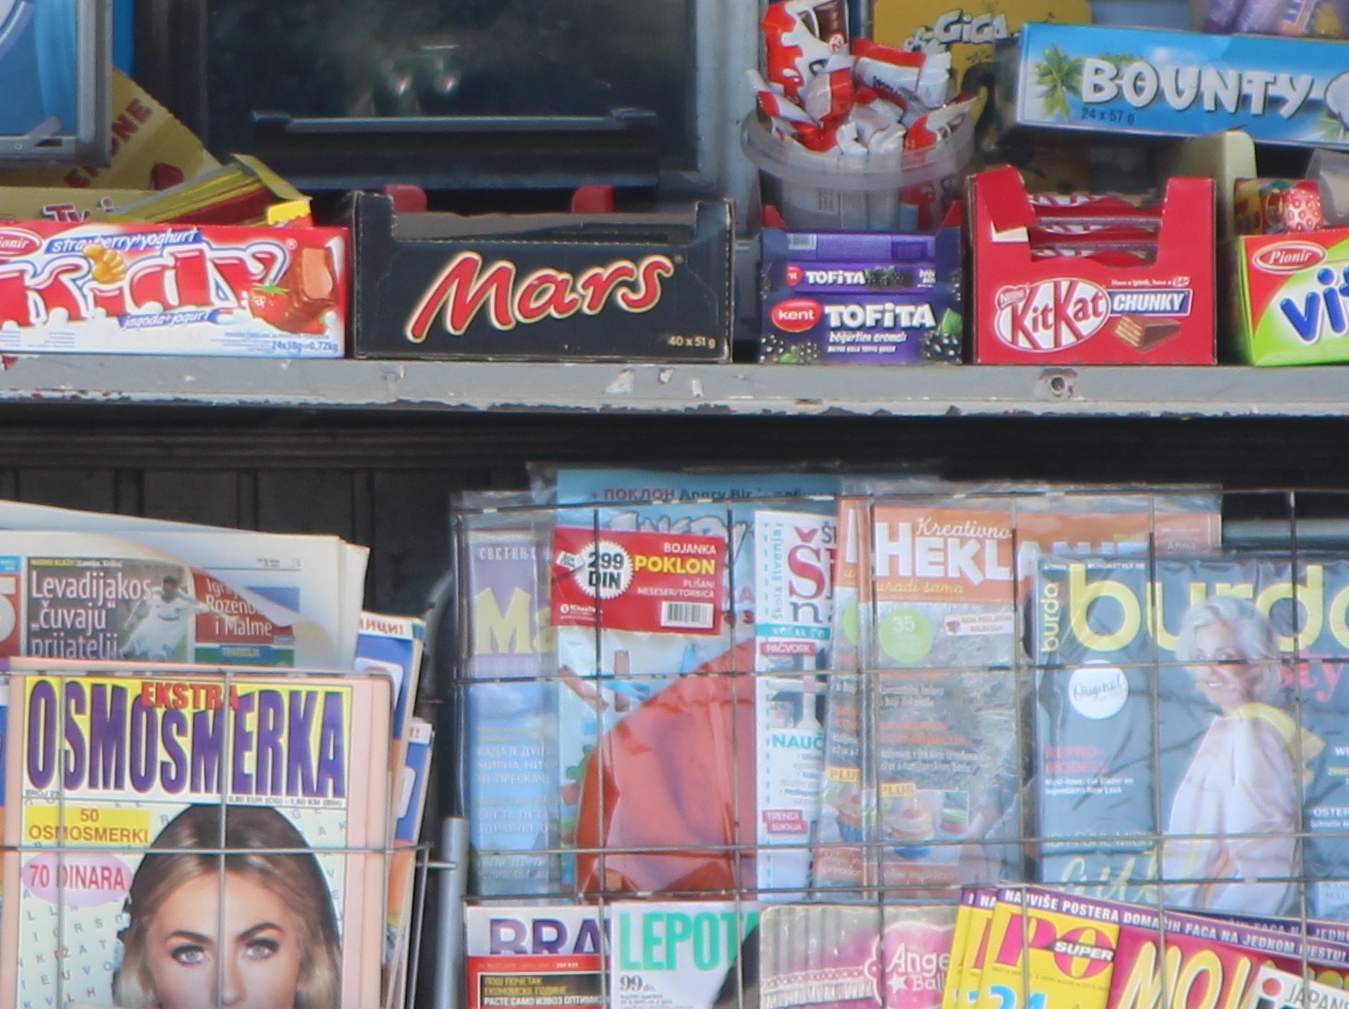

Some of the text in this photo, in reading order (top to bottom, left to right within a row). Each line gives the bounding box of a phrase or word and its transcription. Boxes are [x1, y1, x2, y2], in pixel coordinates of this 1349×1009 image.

[1081, 58, 1315, 120] BOUNTY
[404, 250, 675, 344] Mars
[778, 308, 815, 320] kent
[1009, 278, 1185, 351] KitKat CHUNKY
[916, 516, 1011, 539] Kreativno
[663, 542, 717, 555] BOJANKA
[588, 552, 625, 570] 299
[634, 555, 716, 575] POKLON
[31, 570, 152, 606] Levadijakos
[588, 571, 622, 590] DIN
[26, 679, 348, 798] OSMOSMERKA
[29, 864, 127, 890] 70 DINARA
[1062, 901, 1295, 954] POSTERA FACA JEDNOM
[1054, 941, 1115, 962] SUPER
